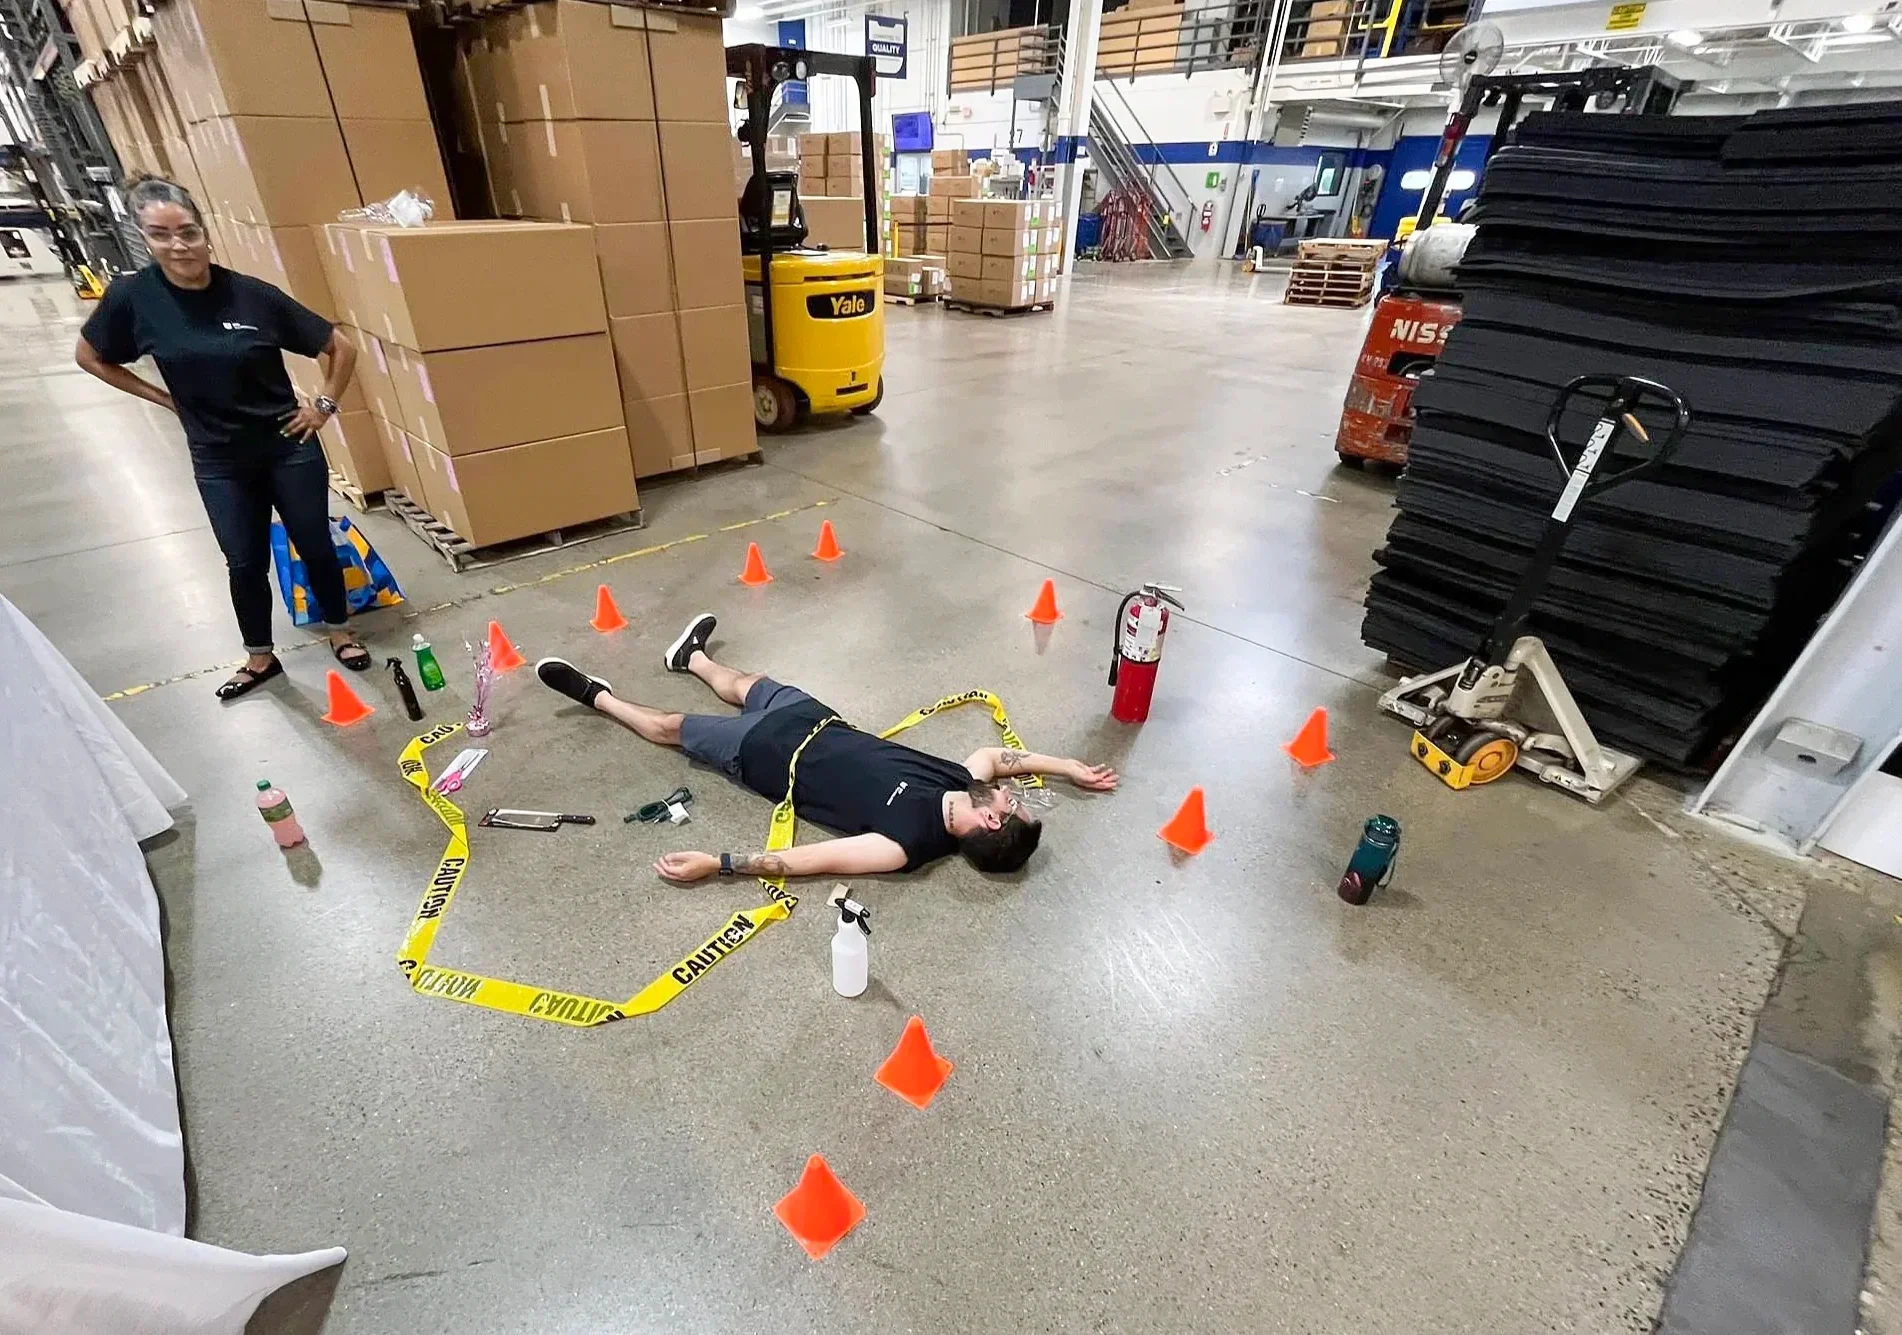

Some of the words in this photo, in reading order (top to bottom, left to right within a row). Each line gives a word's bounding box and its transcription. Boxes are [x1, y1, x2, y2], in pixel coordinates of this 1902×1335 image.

[872, 43, 900, 54] QUALITY
[1016, 128, 1023, 143] 7
[830, 294, 865, 316] Yale
[417, 858, 465, 921] CAUTION
[671, 913, 755, 986] CAUTION
